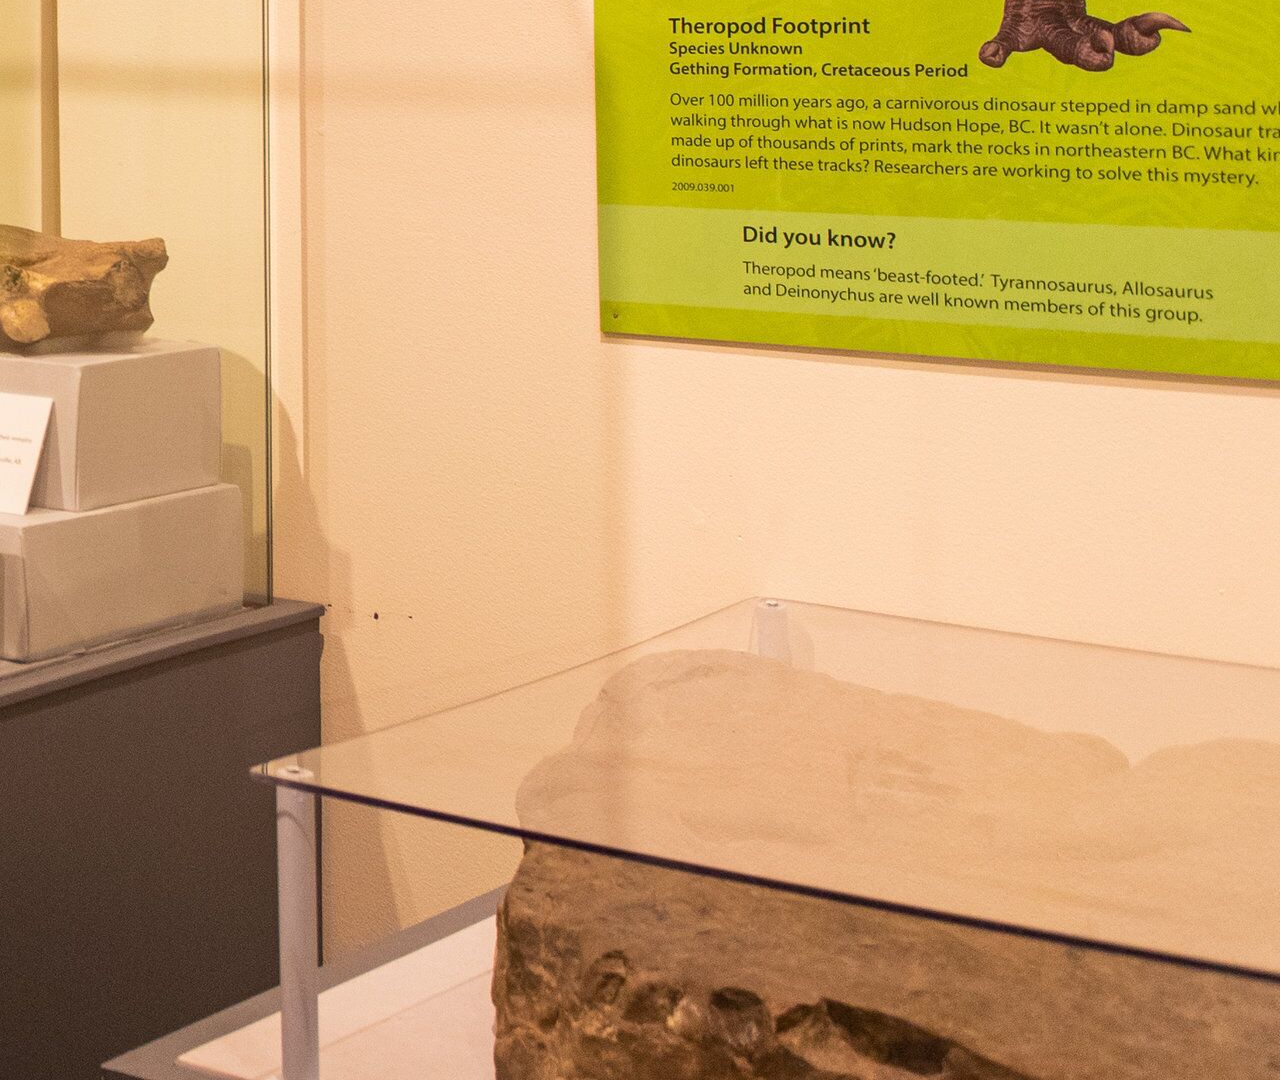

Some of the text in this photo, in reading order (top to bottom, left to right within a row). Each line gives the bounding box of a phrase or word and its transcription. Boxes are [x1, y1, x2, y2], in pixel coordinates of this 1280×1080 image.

[669, 17, 870, 38] Theropod Footprint
[670, 42, 802, 57] Species Unknown
[670, 62, 967, 78] Gething Formation, Cretaceous Period
[670, 93, 1280, 117] Over 100 million years ago, a carnivorous dinosaur stepped in damp sand w
[672, 182, 734, 192] 2009.039.001
[744, 226, 895, 249] Did you know?
[743, 261, 1213, 299] Theropod means ‘beast-footed.’ Tyrannosaurus, Allosaurus
[744, 283, 1202, 324] and Deinonychus are well known members of this group.
